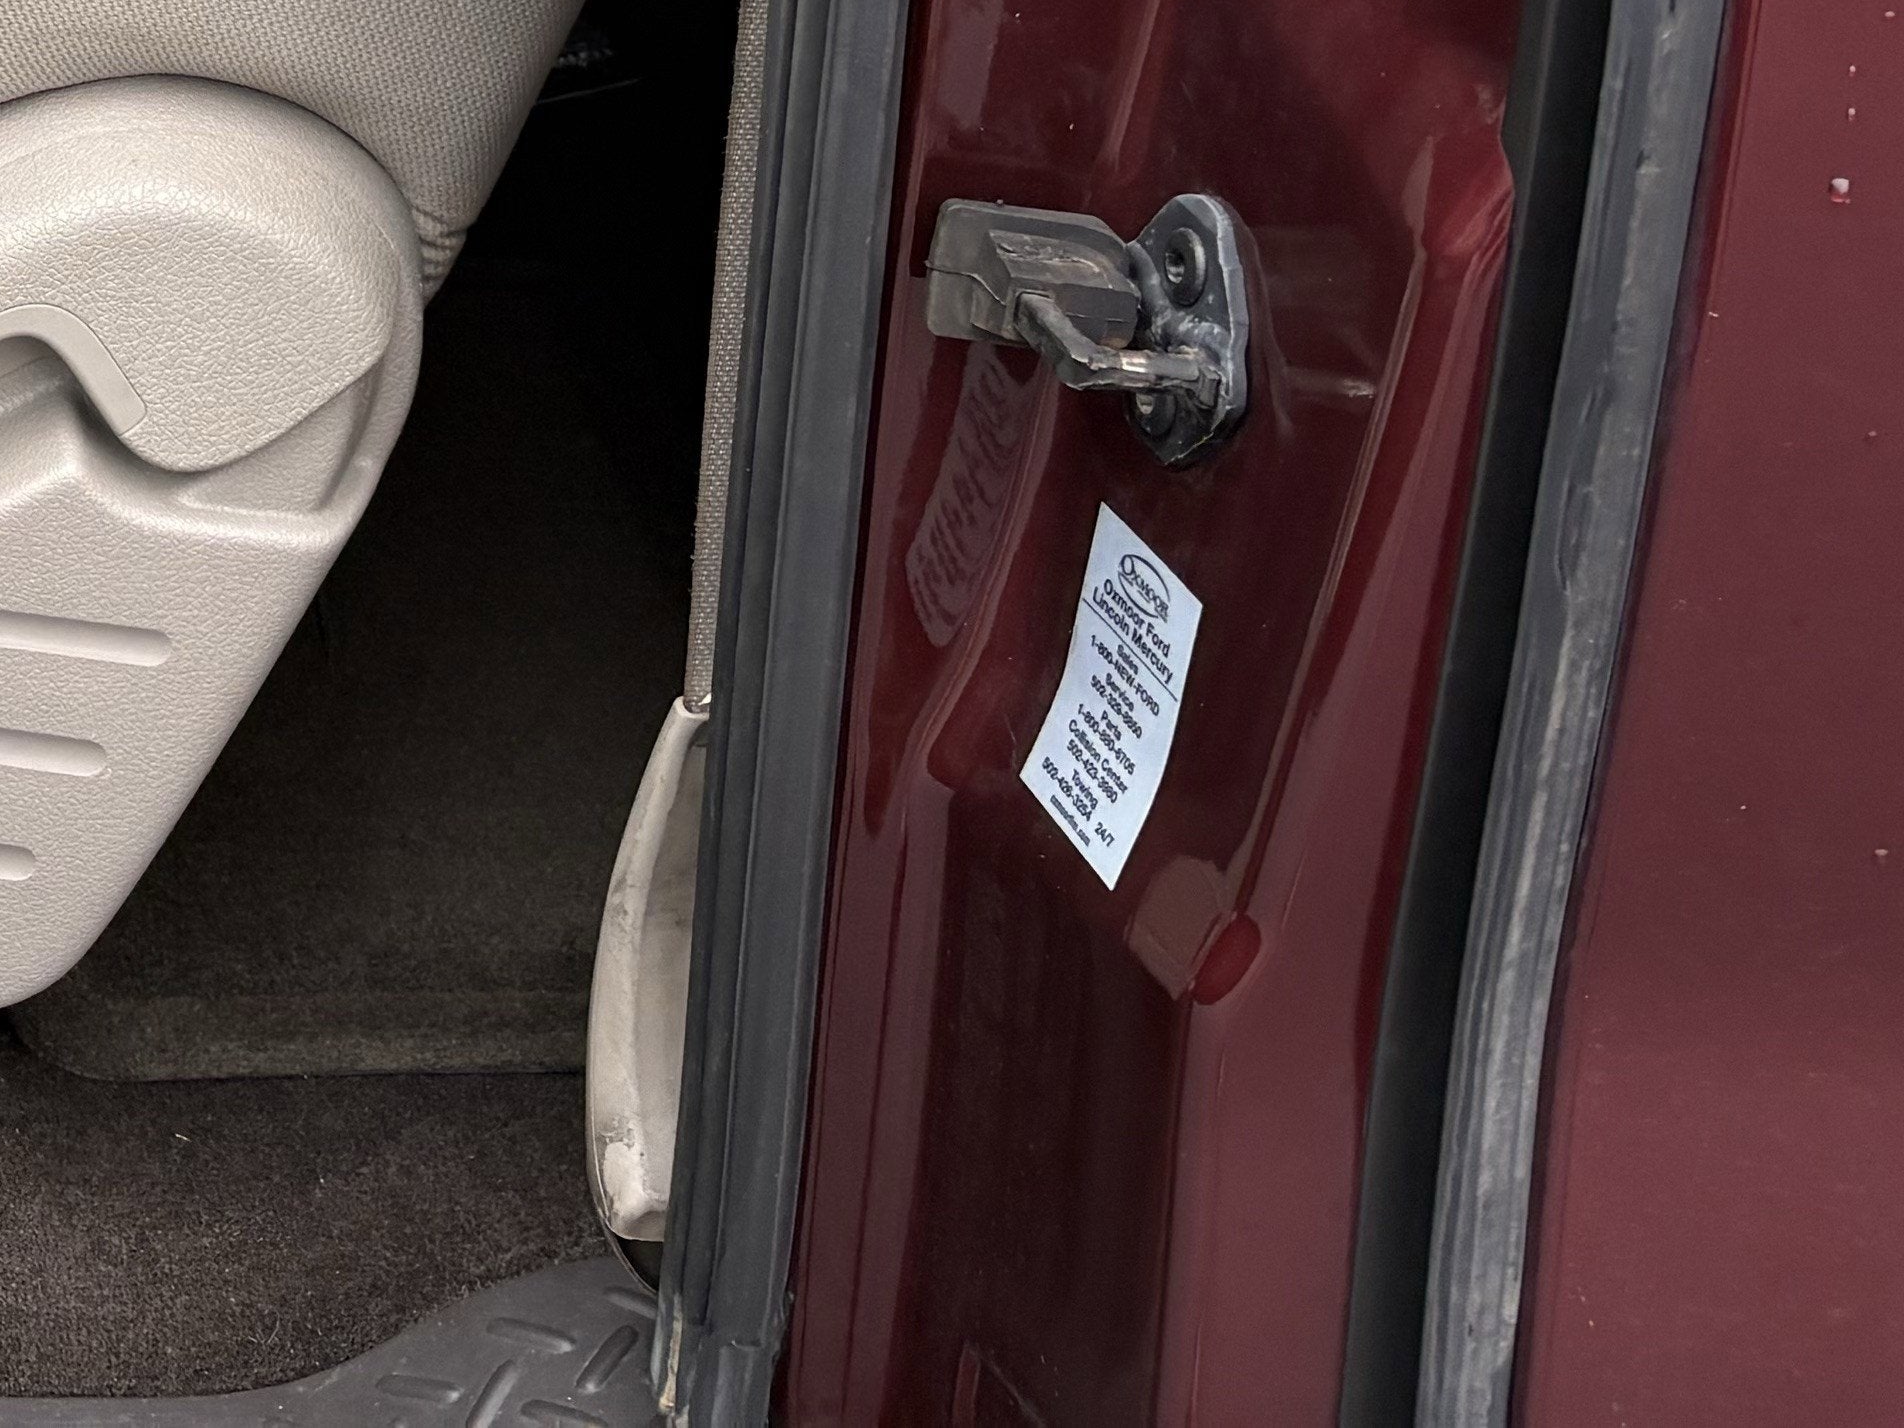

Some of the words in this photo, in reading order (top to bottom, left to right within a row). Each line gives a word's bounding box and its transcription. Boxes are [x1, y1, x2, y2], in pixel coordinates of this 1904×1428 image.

[1092, 586, 1130, 637] Lincoln
[1131, 626, 1174, 685] Mercury
[1103, 578, 1146, 630] Oxmoor
[1145, 622, 1171, 659] Ford
[1116, 644, 1139, 676] Sales
[1105, 672, 1135, 713] Service
[1100, 709, 1122, 742] Parts
[1068, 718, 1102, 763] Collision
[1100, 758, 1129, 795] Center
[1071, 768, 1099, 811] Towing
[1094, 821, 1115, 848] 24/7
